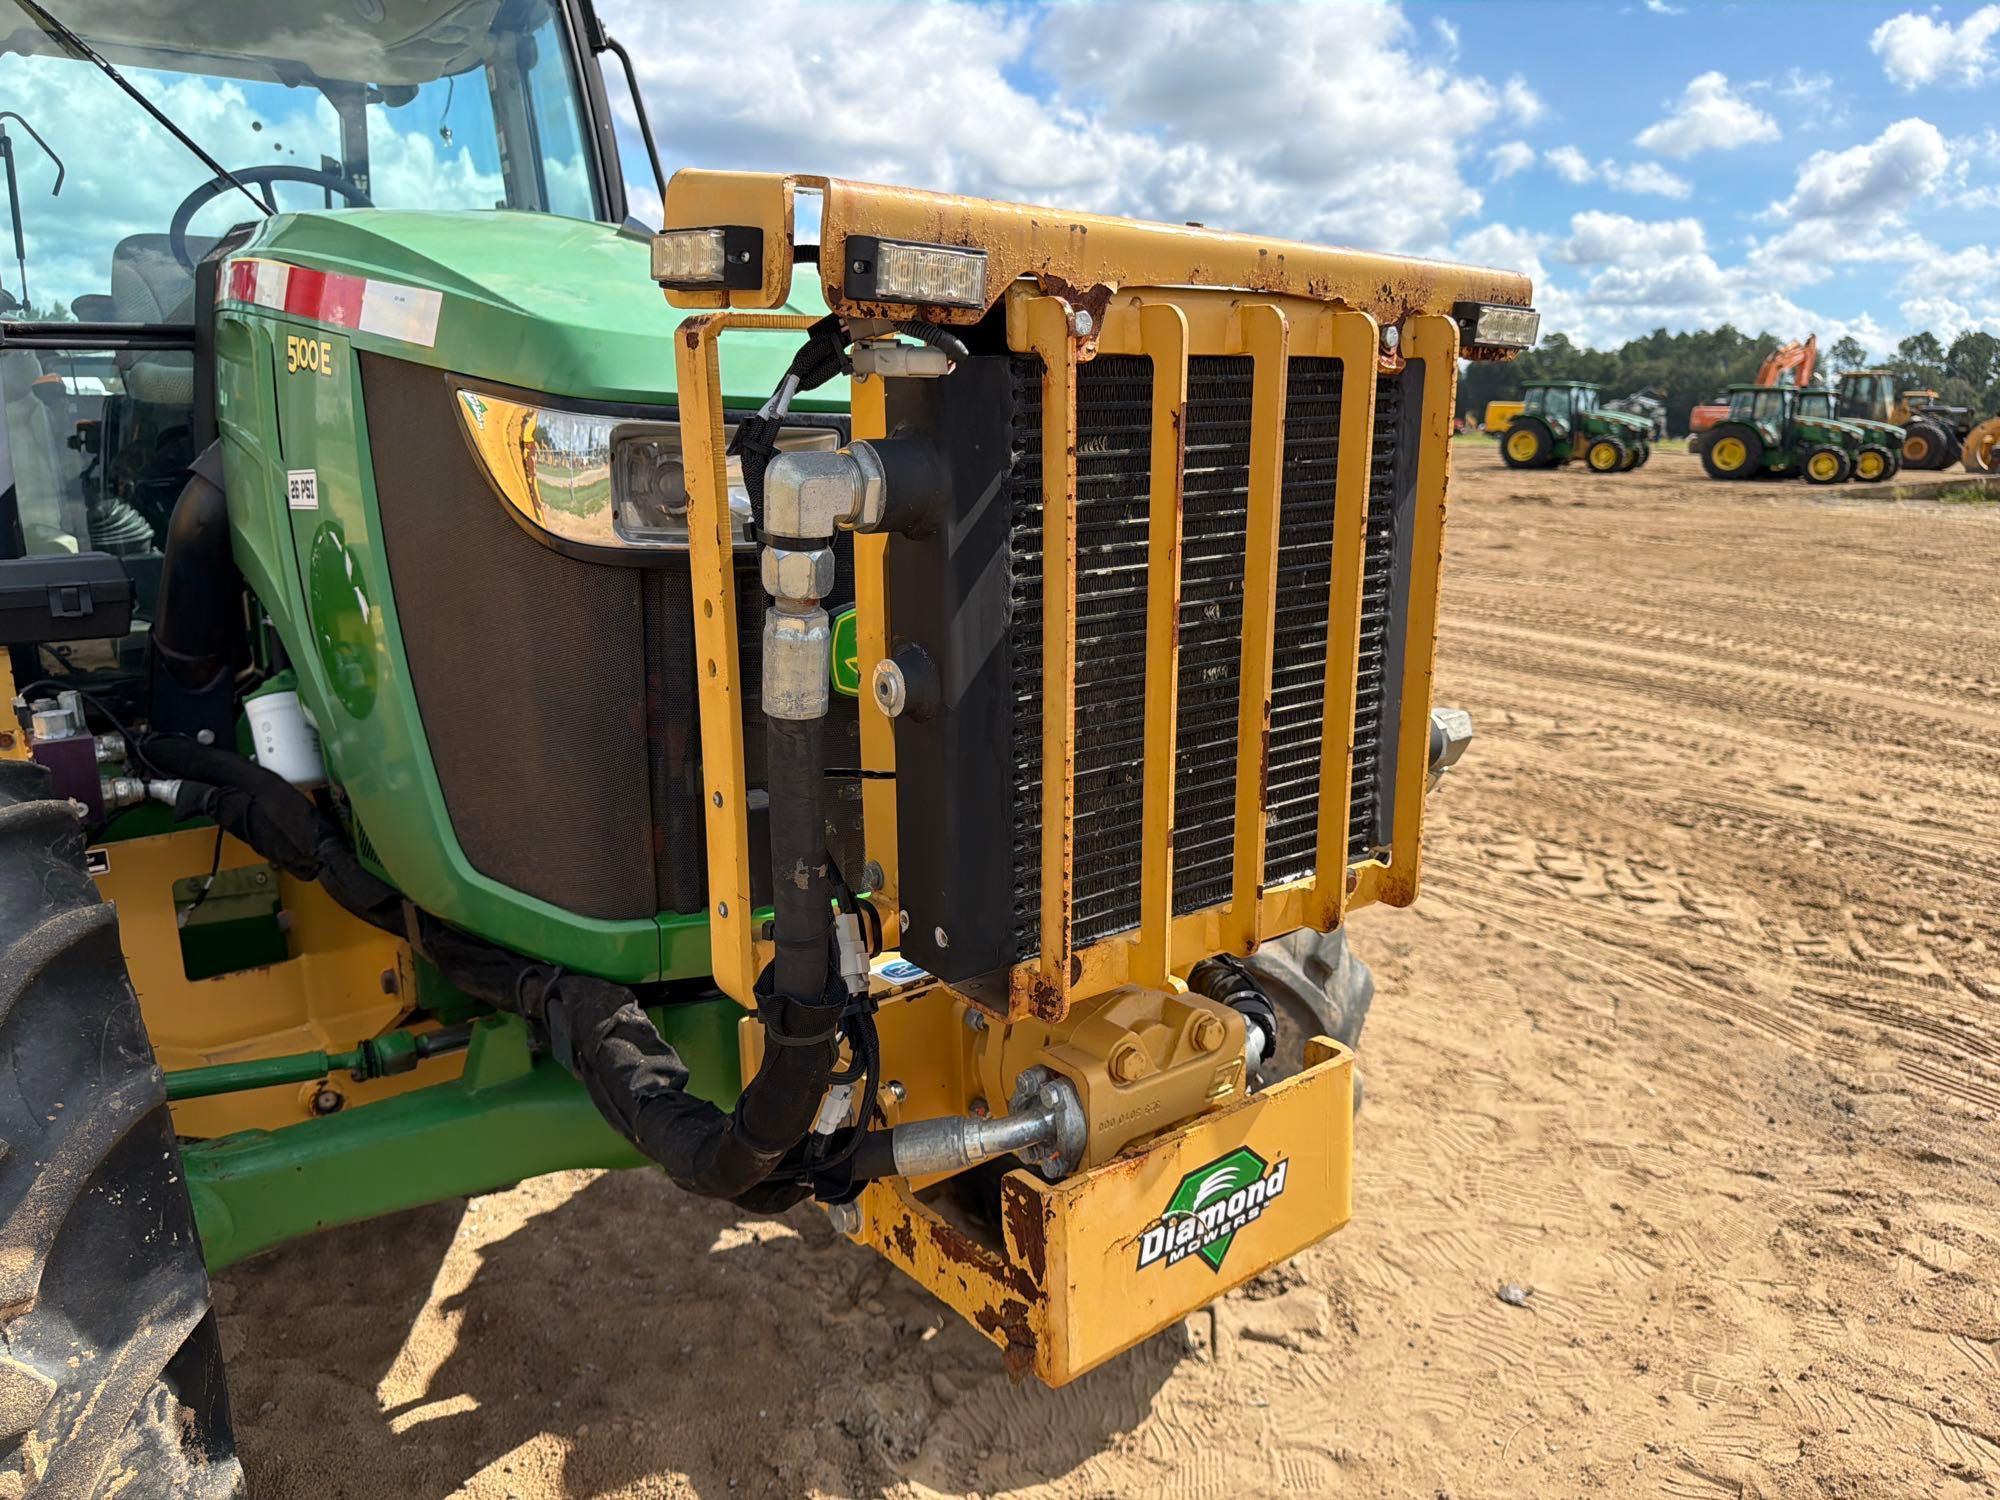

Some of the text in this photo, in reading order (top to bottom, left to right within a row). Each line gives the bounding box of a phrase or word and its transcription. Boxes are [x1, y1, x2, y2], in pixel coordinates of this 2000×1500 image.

[291, 479, 315, 499] 26 PSI
[1139, 1160, 1288, 1267] Diamond
[1169, 1205, 1261, 1264] MOWERS
